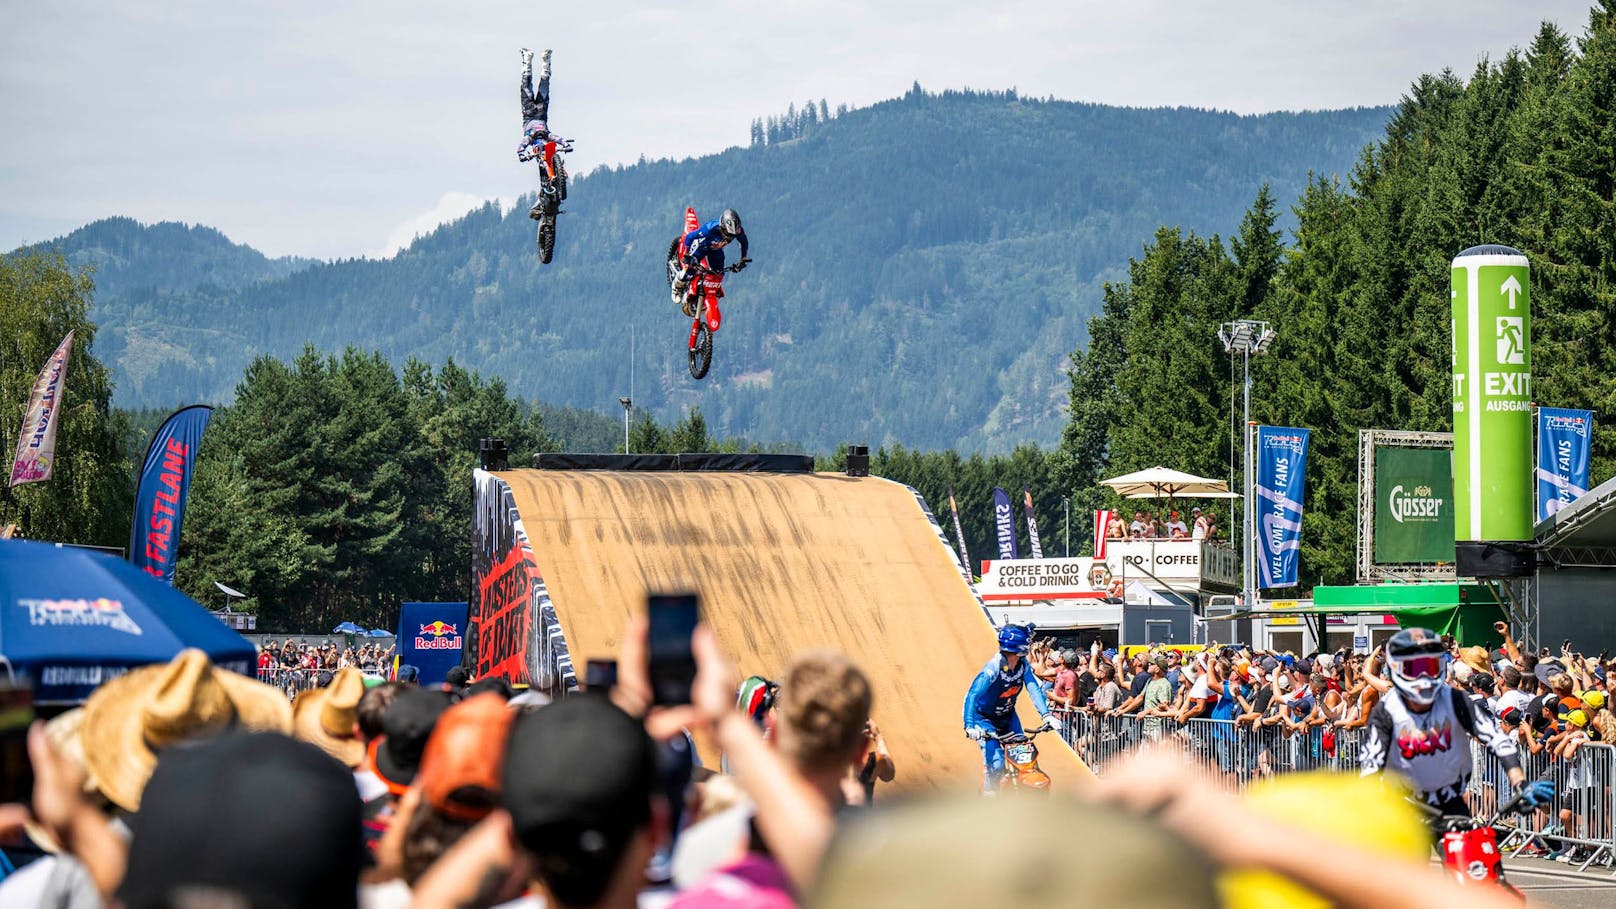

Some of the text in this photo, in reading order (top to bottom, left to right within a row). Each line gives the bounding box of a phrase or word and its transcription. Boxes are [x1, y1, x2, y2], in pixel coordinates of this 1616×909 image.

[1485, 372, 1530, 396] EXIT
[1275, 457, 1289, 488] FANS
[1559, 439, 1571, 505] RACE FANS
[145, 437, 189, 563] FASTLANE
[1273, 490, 1287, 521] RACE
[1389, 485, 1443, 523] Gösser
[1156, 555, 1198, 565] COFFEE
[1272, 523, 1284, 579] WELCOME
[998, 575, 1079, 587] & COLD DRINKS
[999, 563, 1079, 576] COFFEE TO GO
[482, 561, 528, 624] MASTERS
[415, 636, 462, 649] Red Bull
[493, 600, 527, 669] DIRT
